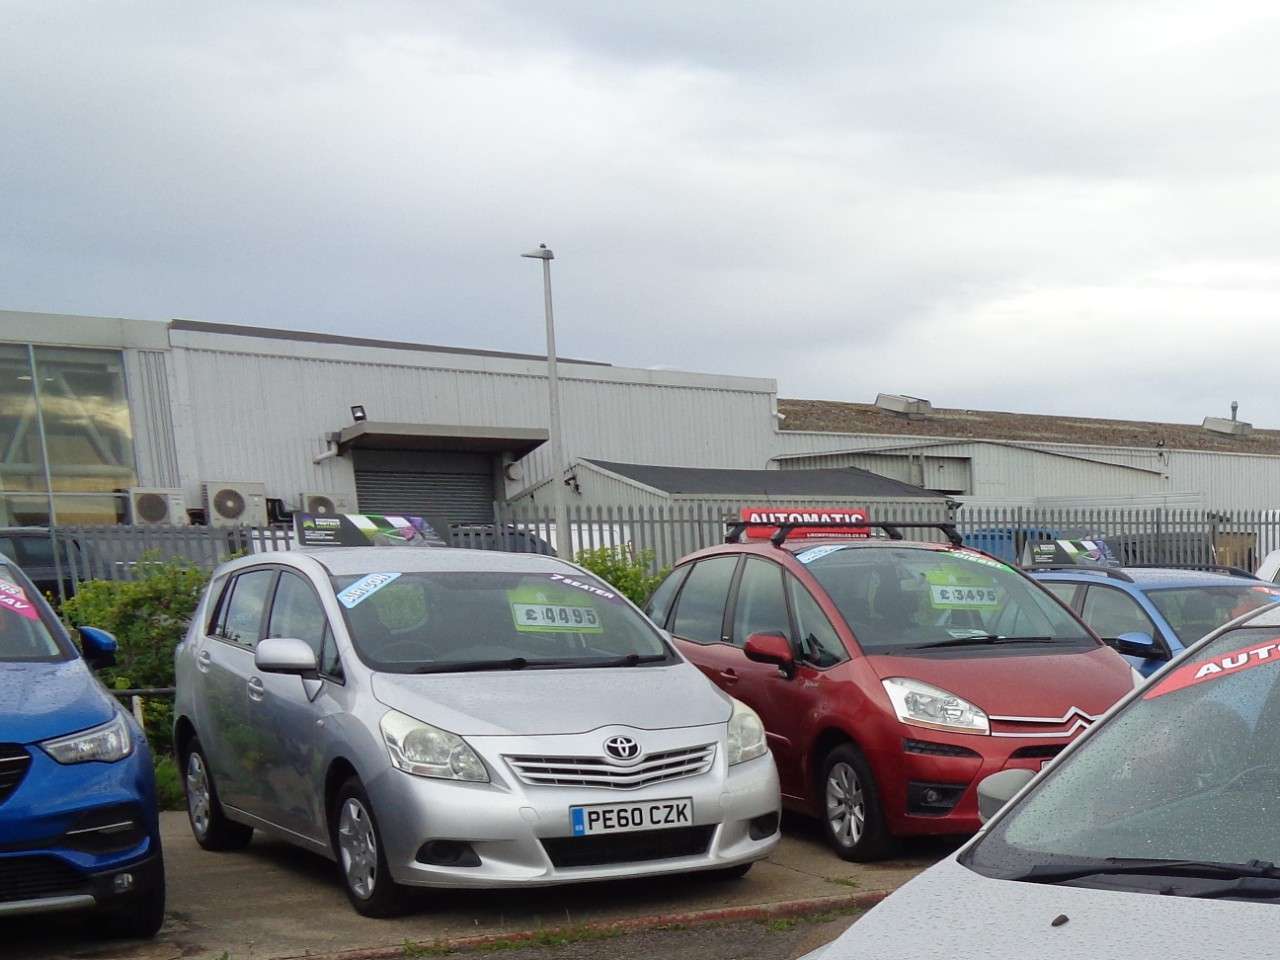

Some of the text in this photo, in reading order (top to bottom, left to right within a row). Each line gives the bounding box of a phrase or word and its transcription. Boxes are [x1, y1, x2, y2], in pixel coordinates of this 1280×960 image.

[562, 578, 615, 598] SEATER
[588, 803, 688, 830] PE60 CZK
